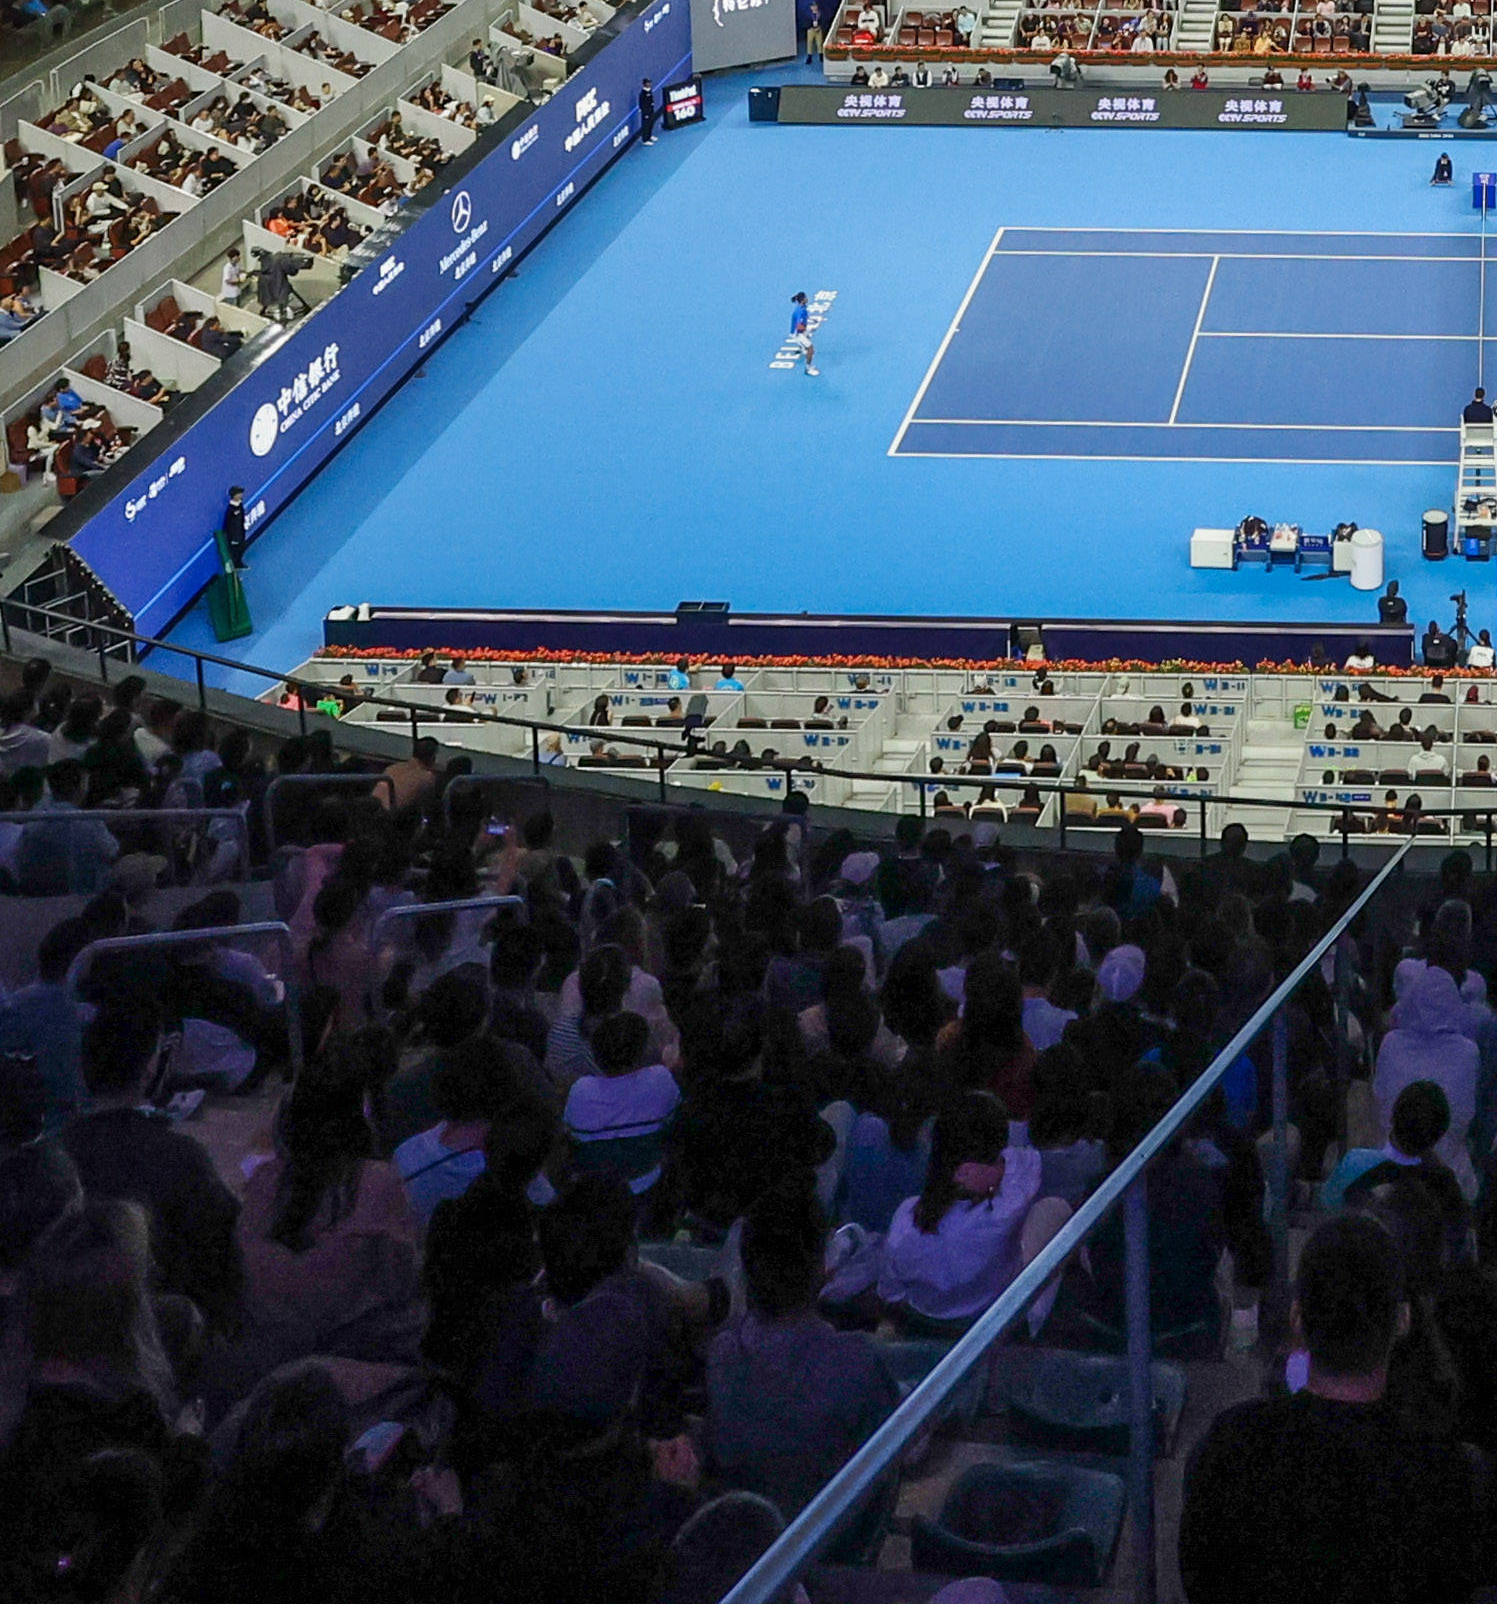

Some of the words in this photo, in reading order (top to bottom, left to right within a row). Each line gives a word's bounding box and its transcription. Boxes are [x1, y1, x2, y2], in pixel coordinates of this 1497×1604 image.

[843, 93, 903, 108] 央视体育
[970, 95, 1029, 110] 央视体育
[1097, 97, 1156, 112] 央视体育
[1224, 98, 1283, 114] 央视体育
[674, 105, 695, 121] 160
[836, 107, 862, 118] CCTV
[860, 108, 907, 118] SPORTS
[963, 109, 989, 119] CCTV
[987, 109, 1034, 120] SPORTS
[1090, 111, 1116, 121] CCTV
[1114, 111, 1161, 121] SPORTS
[1217, 112, 1243, 123] CCTV
[1241, 113, 1288, 123] SPORTS
[439, 220, 488, 275] Mercedes-Benz
[276, 343, 340, 415] 中信银行
[280, 408, 302, 434] CHINA
[302, 389, 322, 415] CITIC
[322, 370, 341, 396] BANK
[1204, 679, 1217, 690] W
[1194, 705, 1208, 715] W
